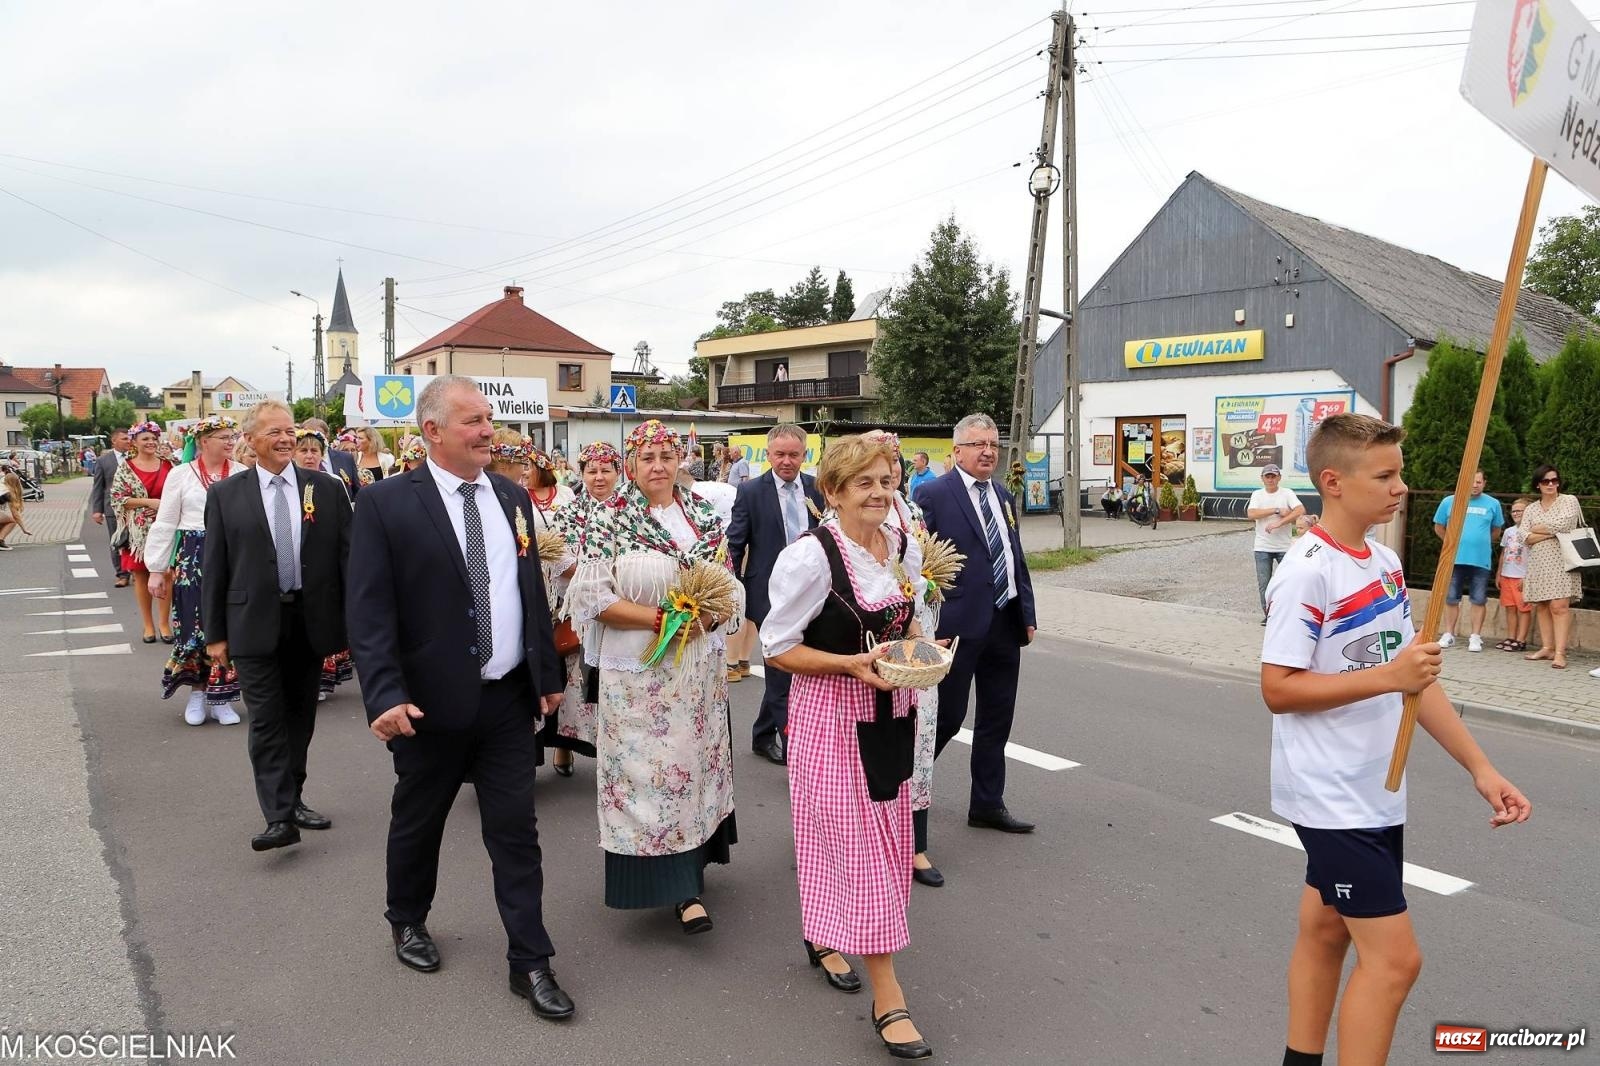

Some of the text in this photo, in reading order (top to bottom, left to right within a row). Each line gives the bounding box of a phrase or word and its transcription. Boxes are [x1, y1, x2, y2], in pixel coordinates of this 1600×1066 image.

[1567, 33, 1600, 107] GM
[1560, 95, 1600, 171] Nędz
[1165, 338, 1247, 359] LEWIATAN
[238, 393, 269, 401] GMINA
[1231, 400, 1260, 408] LEWIATAN
[498, 400, 544, 415] Wielkie
